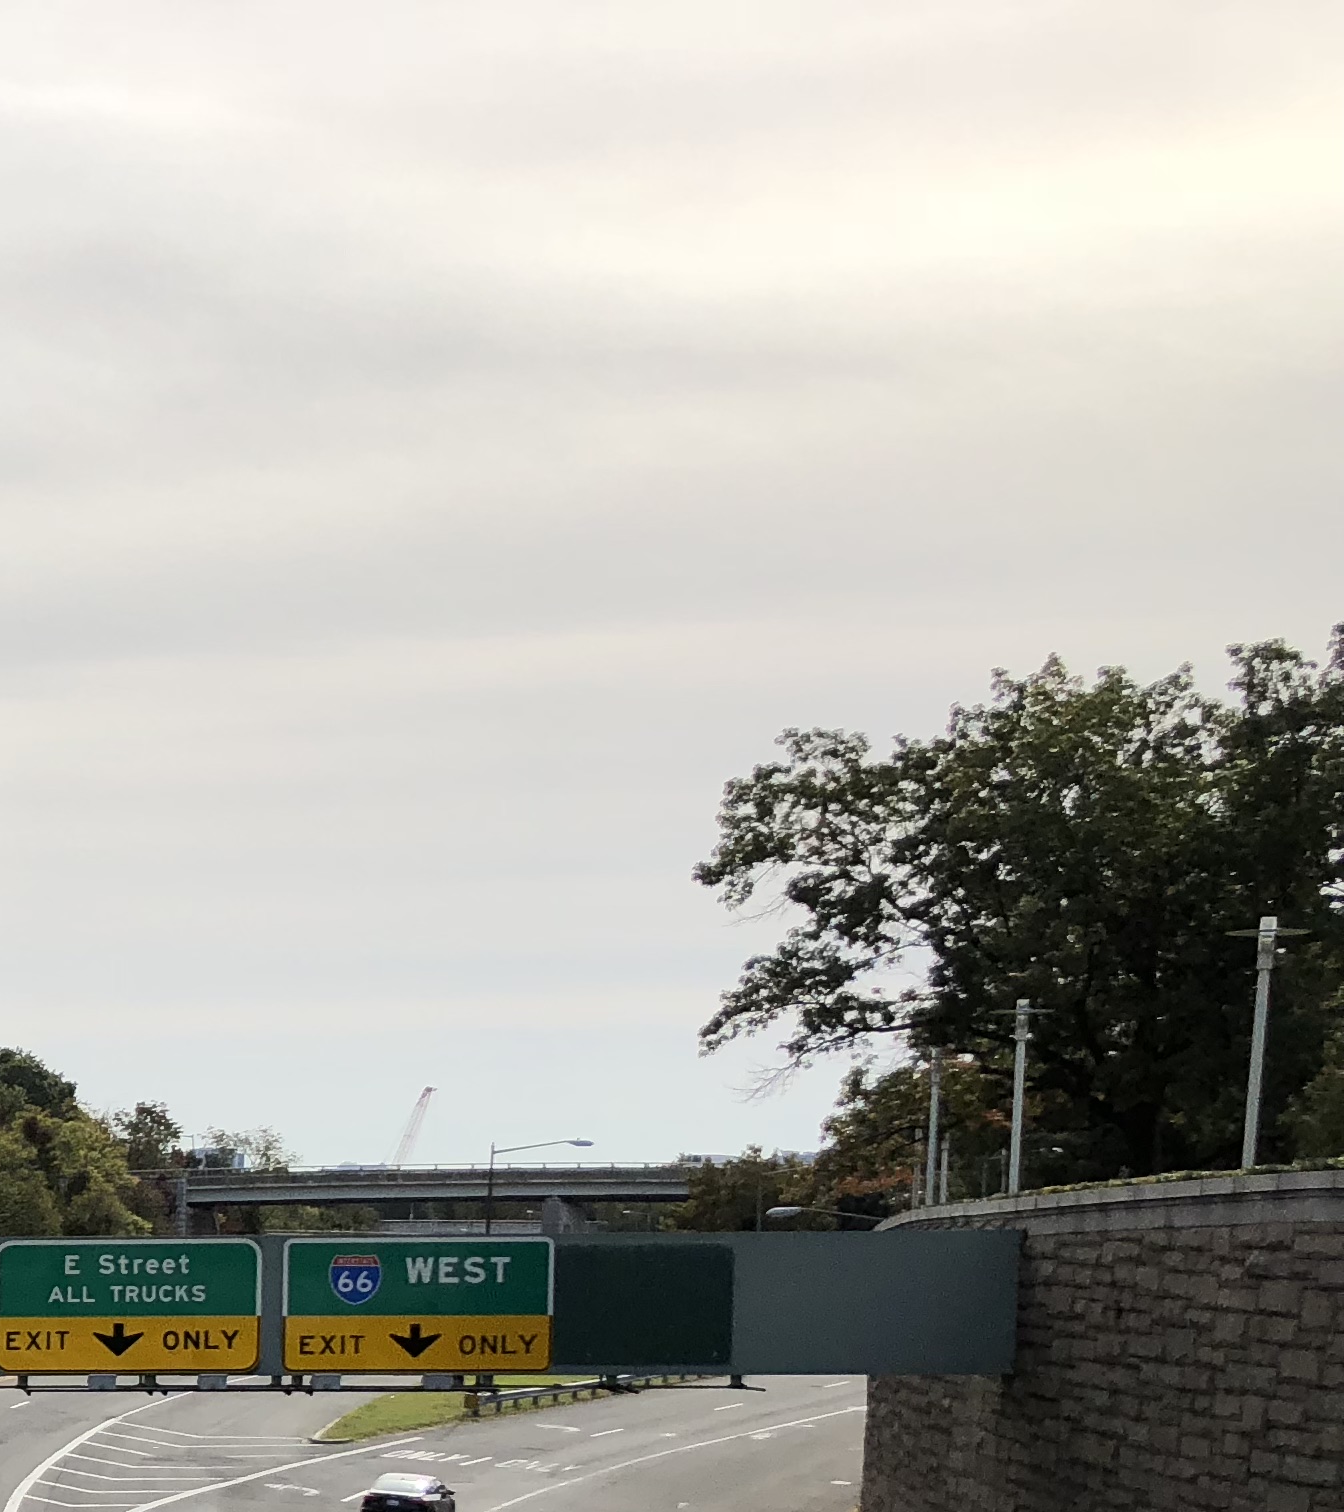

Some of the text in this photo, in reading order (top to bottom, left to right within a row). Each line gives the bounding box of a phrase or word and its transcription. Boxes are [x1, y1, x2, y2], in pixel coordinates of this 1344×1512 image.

[63, 1253, 190, 1275] E Street
[405, 1256, 511, 1284] WEST
[337, 1270, 373, 1293] 66
[47, 1284, 207, 1303] ALL TRUCKS
[4, 1331, 70, 1352] EXIT
[162, 1330, 239, 1351] ONLY
[298, 1334, 366, 1356] EXIT
[458, 1333, 539, 1355] ONLY
[379, 1449, 471, 1462] ONLY
